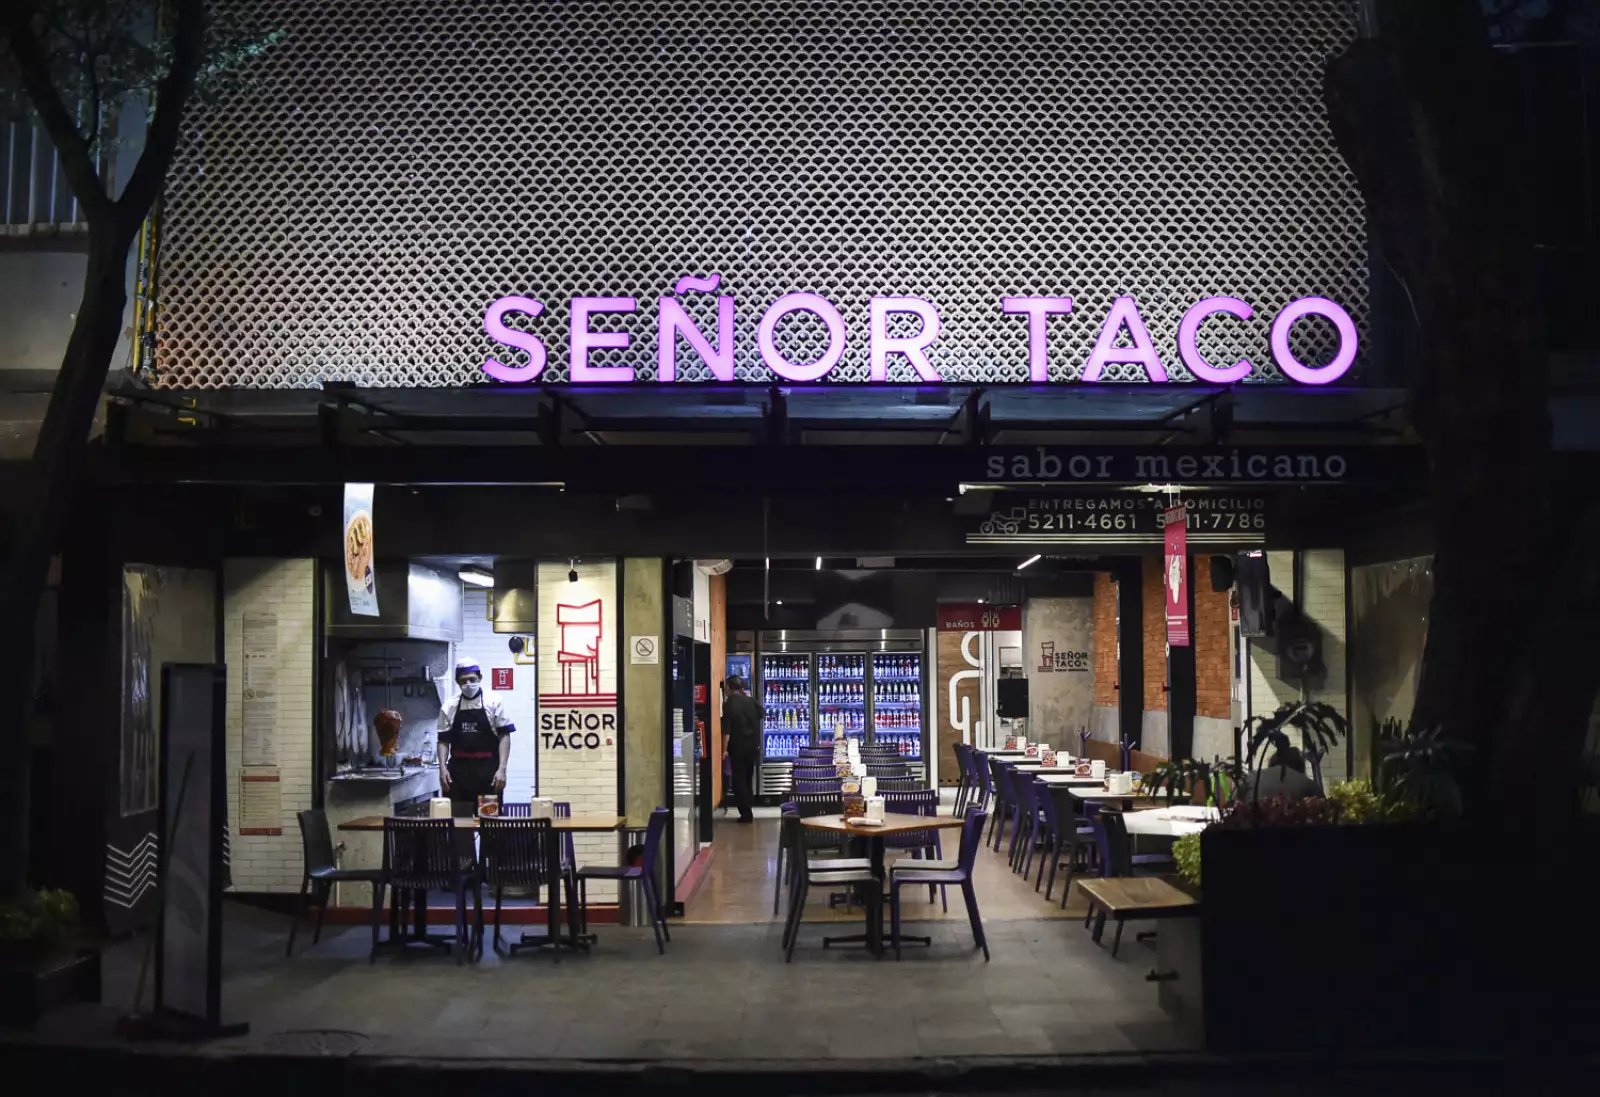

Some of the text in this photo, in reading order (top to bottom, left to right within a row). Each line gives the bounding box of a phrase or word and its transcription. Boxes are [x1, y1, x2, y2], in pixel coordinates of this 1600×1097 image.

[482, 273, 1358, 385] SEÑOR TACO
[986, 447, 1347, 478] sabor mexicano
[1028, 498, 1265, 510] ENTREGAMOS A DOMICILIO
[1155, 513, 1265, 529] 511·7786
[945, 620, 975, 629] BAÑOS
[1055, 651, 1088, 660] SEÑOR
[1055, 660, 1081, 668] TACO
[541, 709, 615, 730] SEÑOR
[541, 732, 600, 749] TACO
